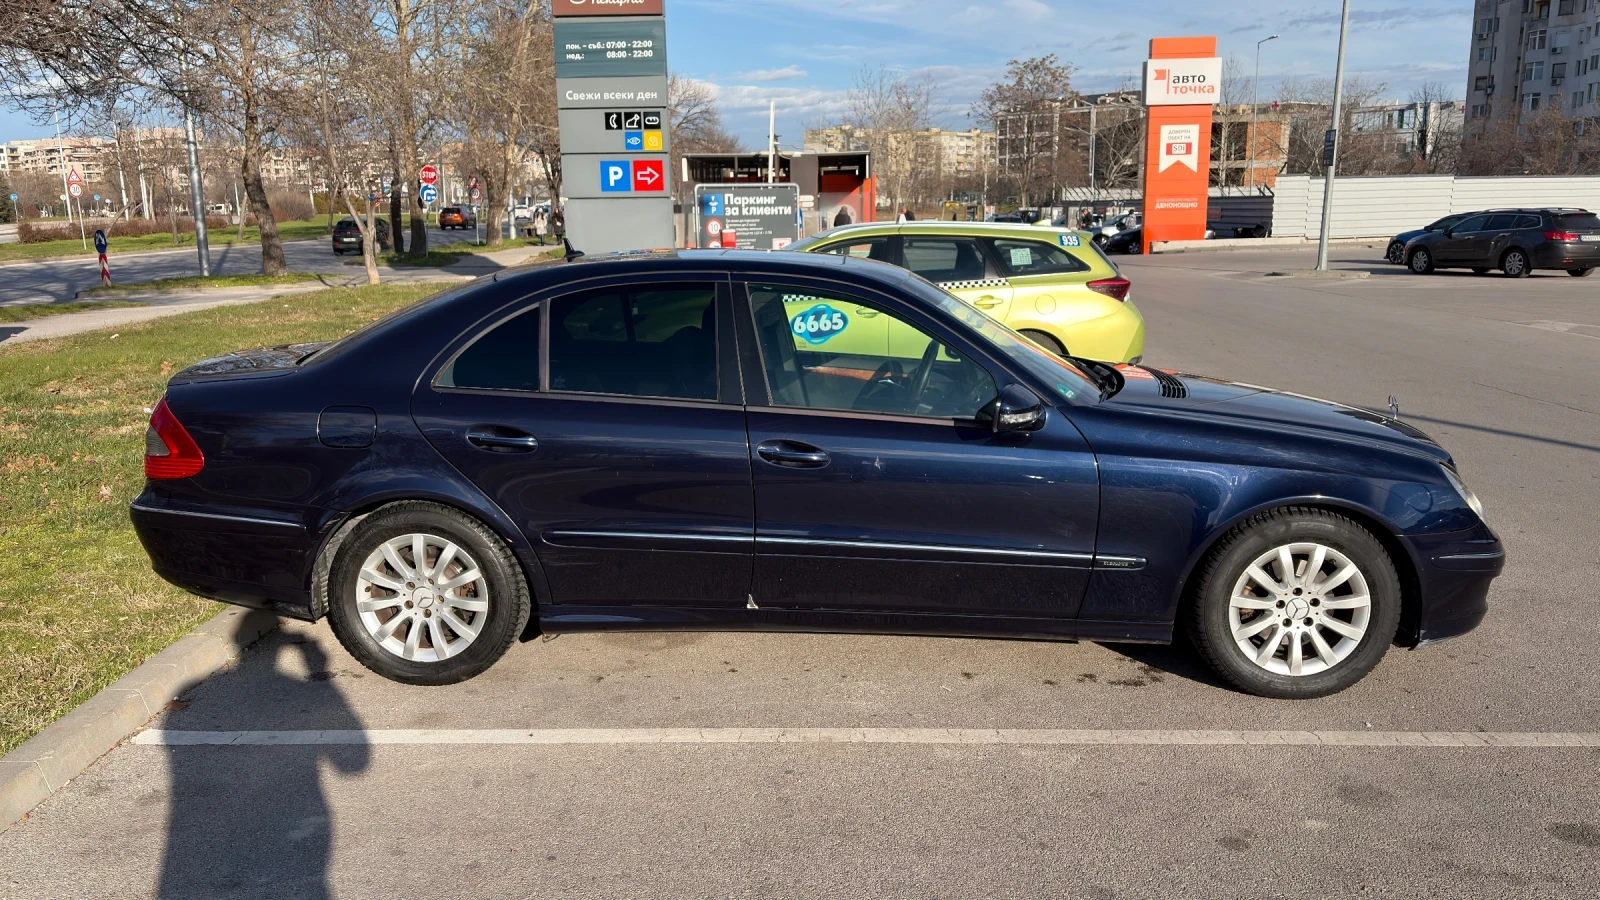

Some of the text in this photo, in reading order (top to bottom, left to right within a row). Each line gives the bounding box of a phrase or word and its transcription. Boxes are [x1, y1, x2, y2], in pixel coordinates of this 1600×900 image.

[606, 41, 626, 49] 07:00
[632, 40, 653, 48] 22:00
[606, 51, 627, 59] 08:00
[633, 50, 653, 58] 22:00
[1172, 74, 1205, 84] авто
[1172, 84, 1215, 95] точка
[566, 90, 657, 101] Свежи всеки ден
[422, 171, 436, 179] STOP
[609, 166, 623, 187] P
[71, 186, 80, 194] 30
[724, 193, 777, 207] Паркинг
[724, 206, 792, 216] за клиенти
[710, 223, 719, 232] 10
[1062, 235, 1079, 246] 935
[793, 312, 844, 333] 6665
